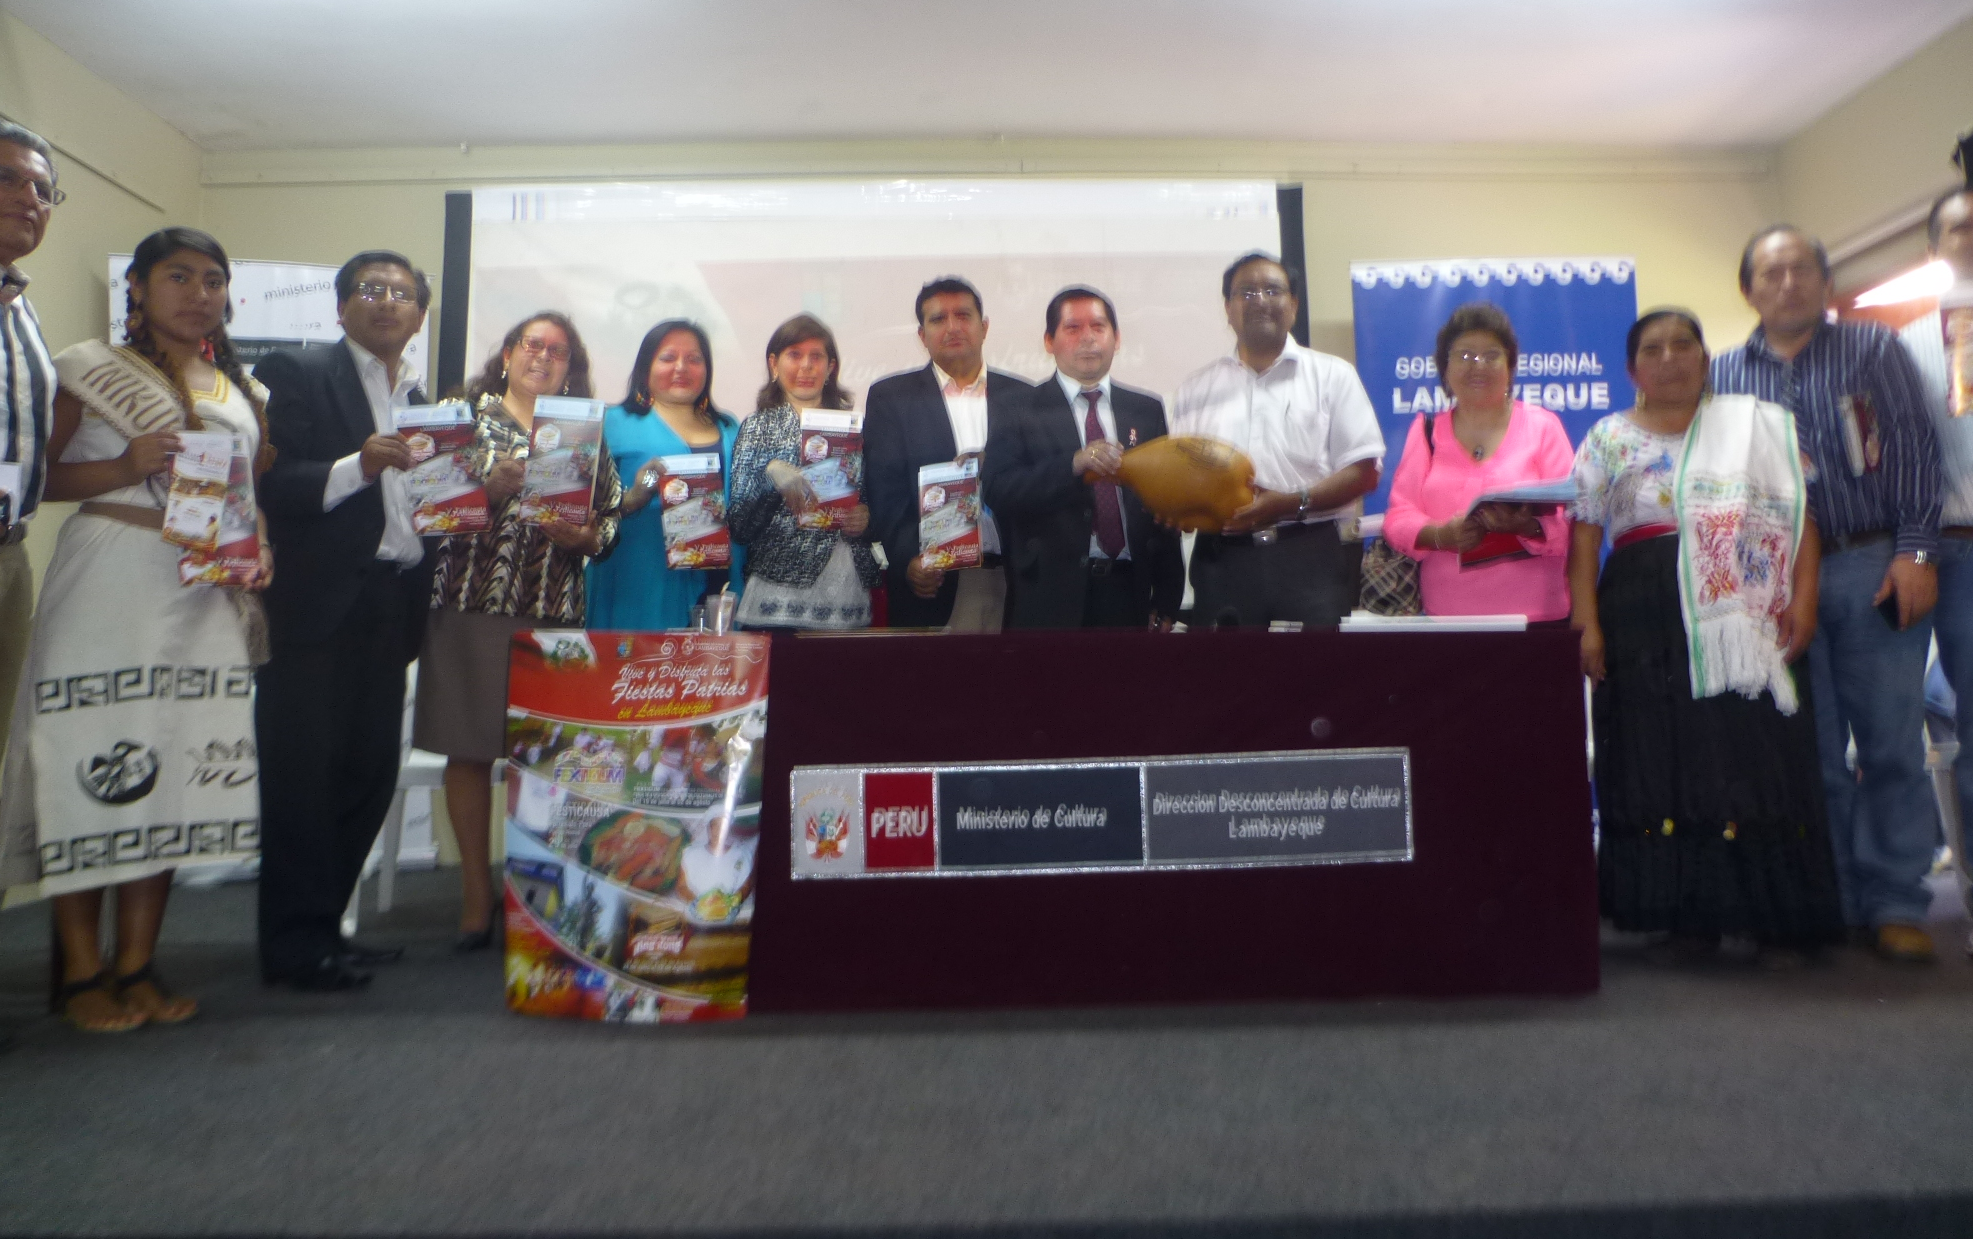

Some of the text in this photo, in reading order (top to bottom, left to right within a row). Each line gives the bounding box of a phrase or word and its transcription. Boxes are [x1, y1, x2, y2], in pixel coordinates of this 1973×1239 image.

[264, 280, 331, 301] ministerio
[1516, 351, 1603, 377] EGIONAL
[1392, 382, 1610, 414] LAMEQUE
[619, 662, 730, 681] Vive y Disfruta las
[611, 679, 748, 704] Fiestas Patrias
[617, 701, 713, 719] en Lambayeque
[1153, 786, 1400, 815] Direccion Desconcentrada de Cultura
[871, 804, 1107, 838] PERU Ministerio de Cultura
[1229, 815, 1325, 841] Lambayeque
